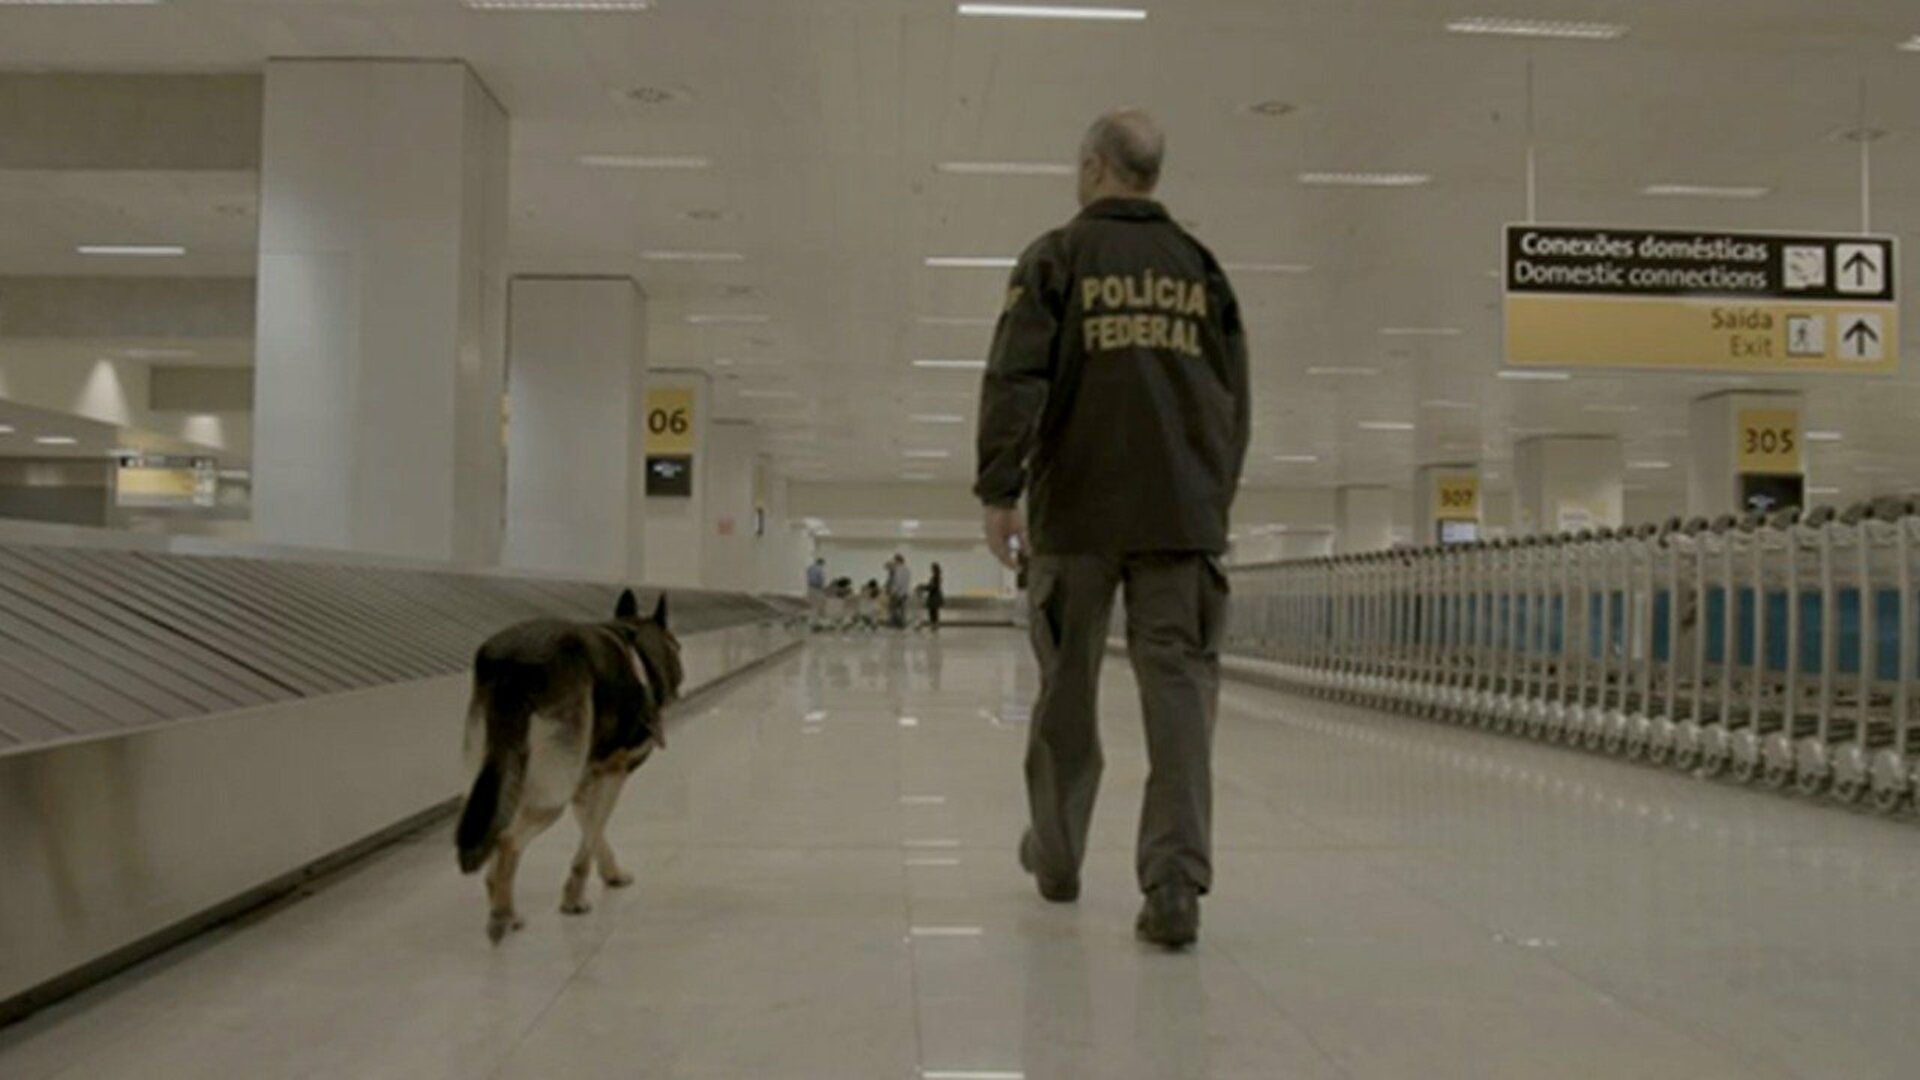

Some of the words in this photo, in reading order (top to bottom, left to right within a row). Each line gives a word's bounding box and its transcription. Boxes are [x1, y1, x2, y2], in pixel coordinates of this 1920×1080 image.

[1521, 232, 1633, 258] Conexões
[1639, 235, 1768, 262] domésticas
[1515, 261, 1624, 285] Domestic
[1628, 264, 1768, 290] connections
[1081, 269, 1207, 316] POLÍCIA
[1082, 314, 1202, 356] FEDERAL
[1730, 337, 1774, 358] Exit
[648, 408, 688, 435] 06
[1744, 427, 1794, 454] 305
